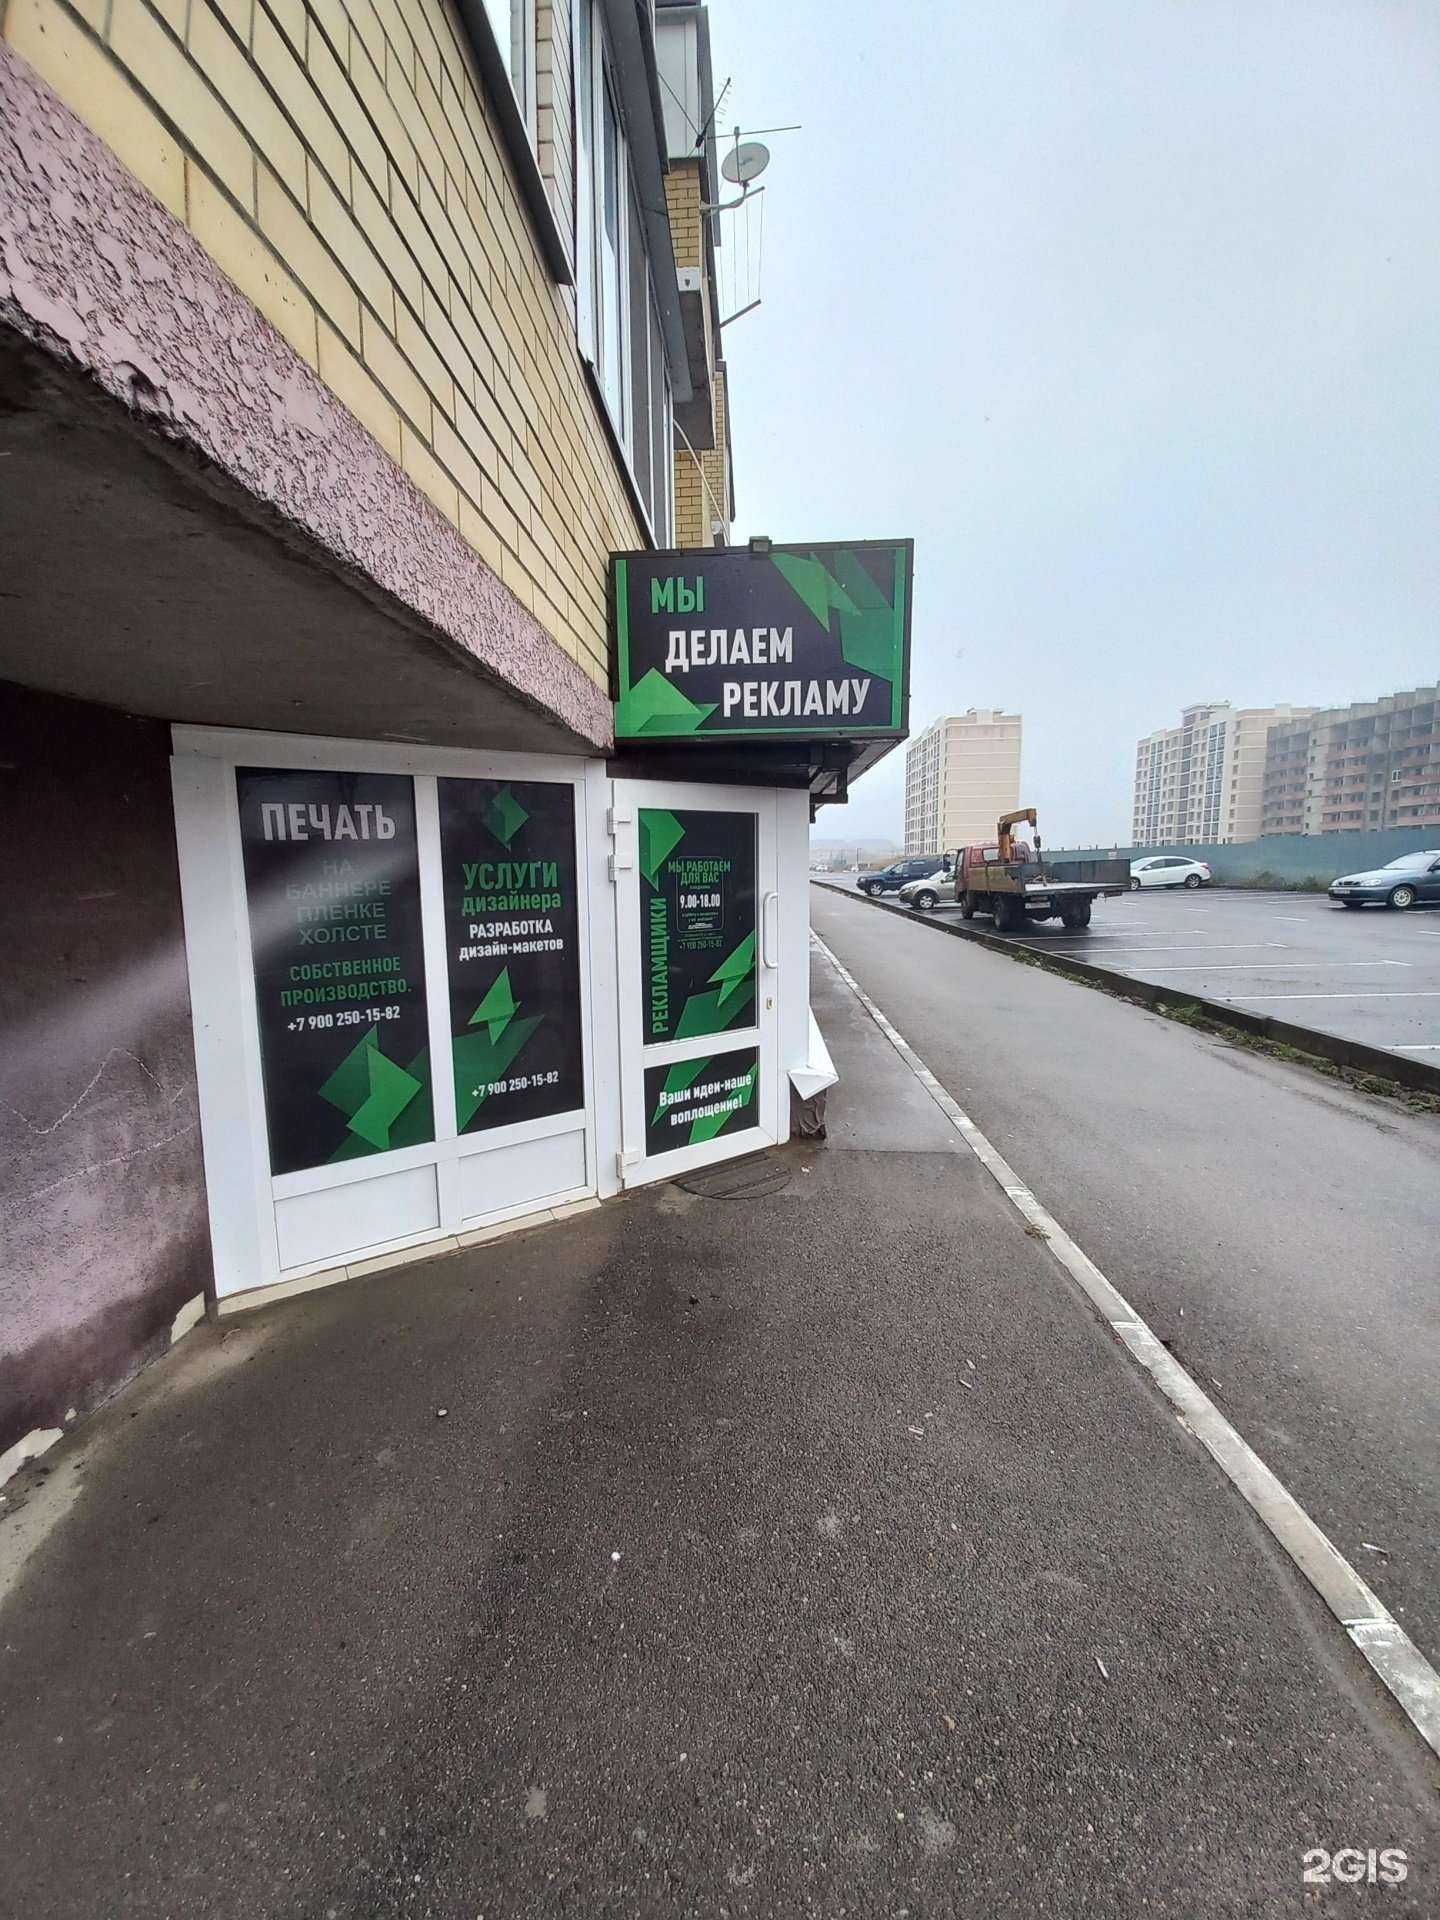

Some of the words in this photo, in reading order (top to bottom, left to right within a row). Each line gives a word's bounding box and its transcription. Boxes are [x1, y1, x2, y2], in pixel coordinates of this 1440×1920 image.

[651, 575, 705, 614] МЫ
[664, 627, 793, 673] ДЕЛАЕМ
[722, 678, 871, 718] РЕКЛАМУ
[261, 803, 396, 841] ПЕЧАТЬ
[462, 861, 558, 890] УСЛУГИ
[668, 860, 685, 872] МЫ
[686, 860, 731, 873] РАБОТАЕМ
[680, 872, 701, 886] ДЛЯ
[702, 871, 720, 883] ВАС
[286, 880, 392, 900] БАННЕРЕ
[680, 893, 721, 909] 9.00-18.00
[297, 902, 386, 923] ПЛЕНКЕ
[462, 890, 561, 917] дизайнера
[299, 924, 387, 945] ХОЛСТЕ
[469, 919, 554, 939] РАЗРАБОТКА
[459, 938, 564, 961] дизайн-макетов
[290, 957, 401, 981] СОБСТВЕННОЕ
[650, 897, 670, 1034] РЕКЛАМЩИКИ
[287, 1017, 305, 1032] +7
[308, 1014, 334, 1029] 900
[336, 1005, 401, 1026] 250-15-82
[472, 1084, 486, 1097] +7
[487, 1080, 507, 1095] 900
[509, 1070, 559, 1092] 250-15-82
[659, 1087, 691, 1107] Ваши
[670, 1094, 743, 1126] воплощение!
